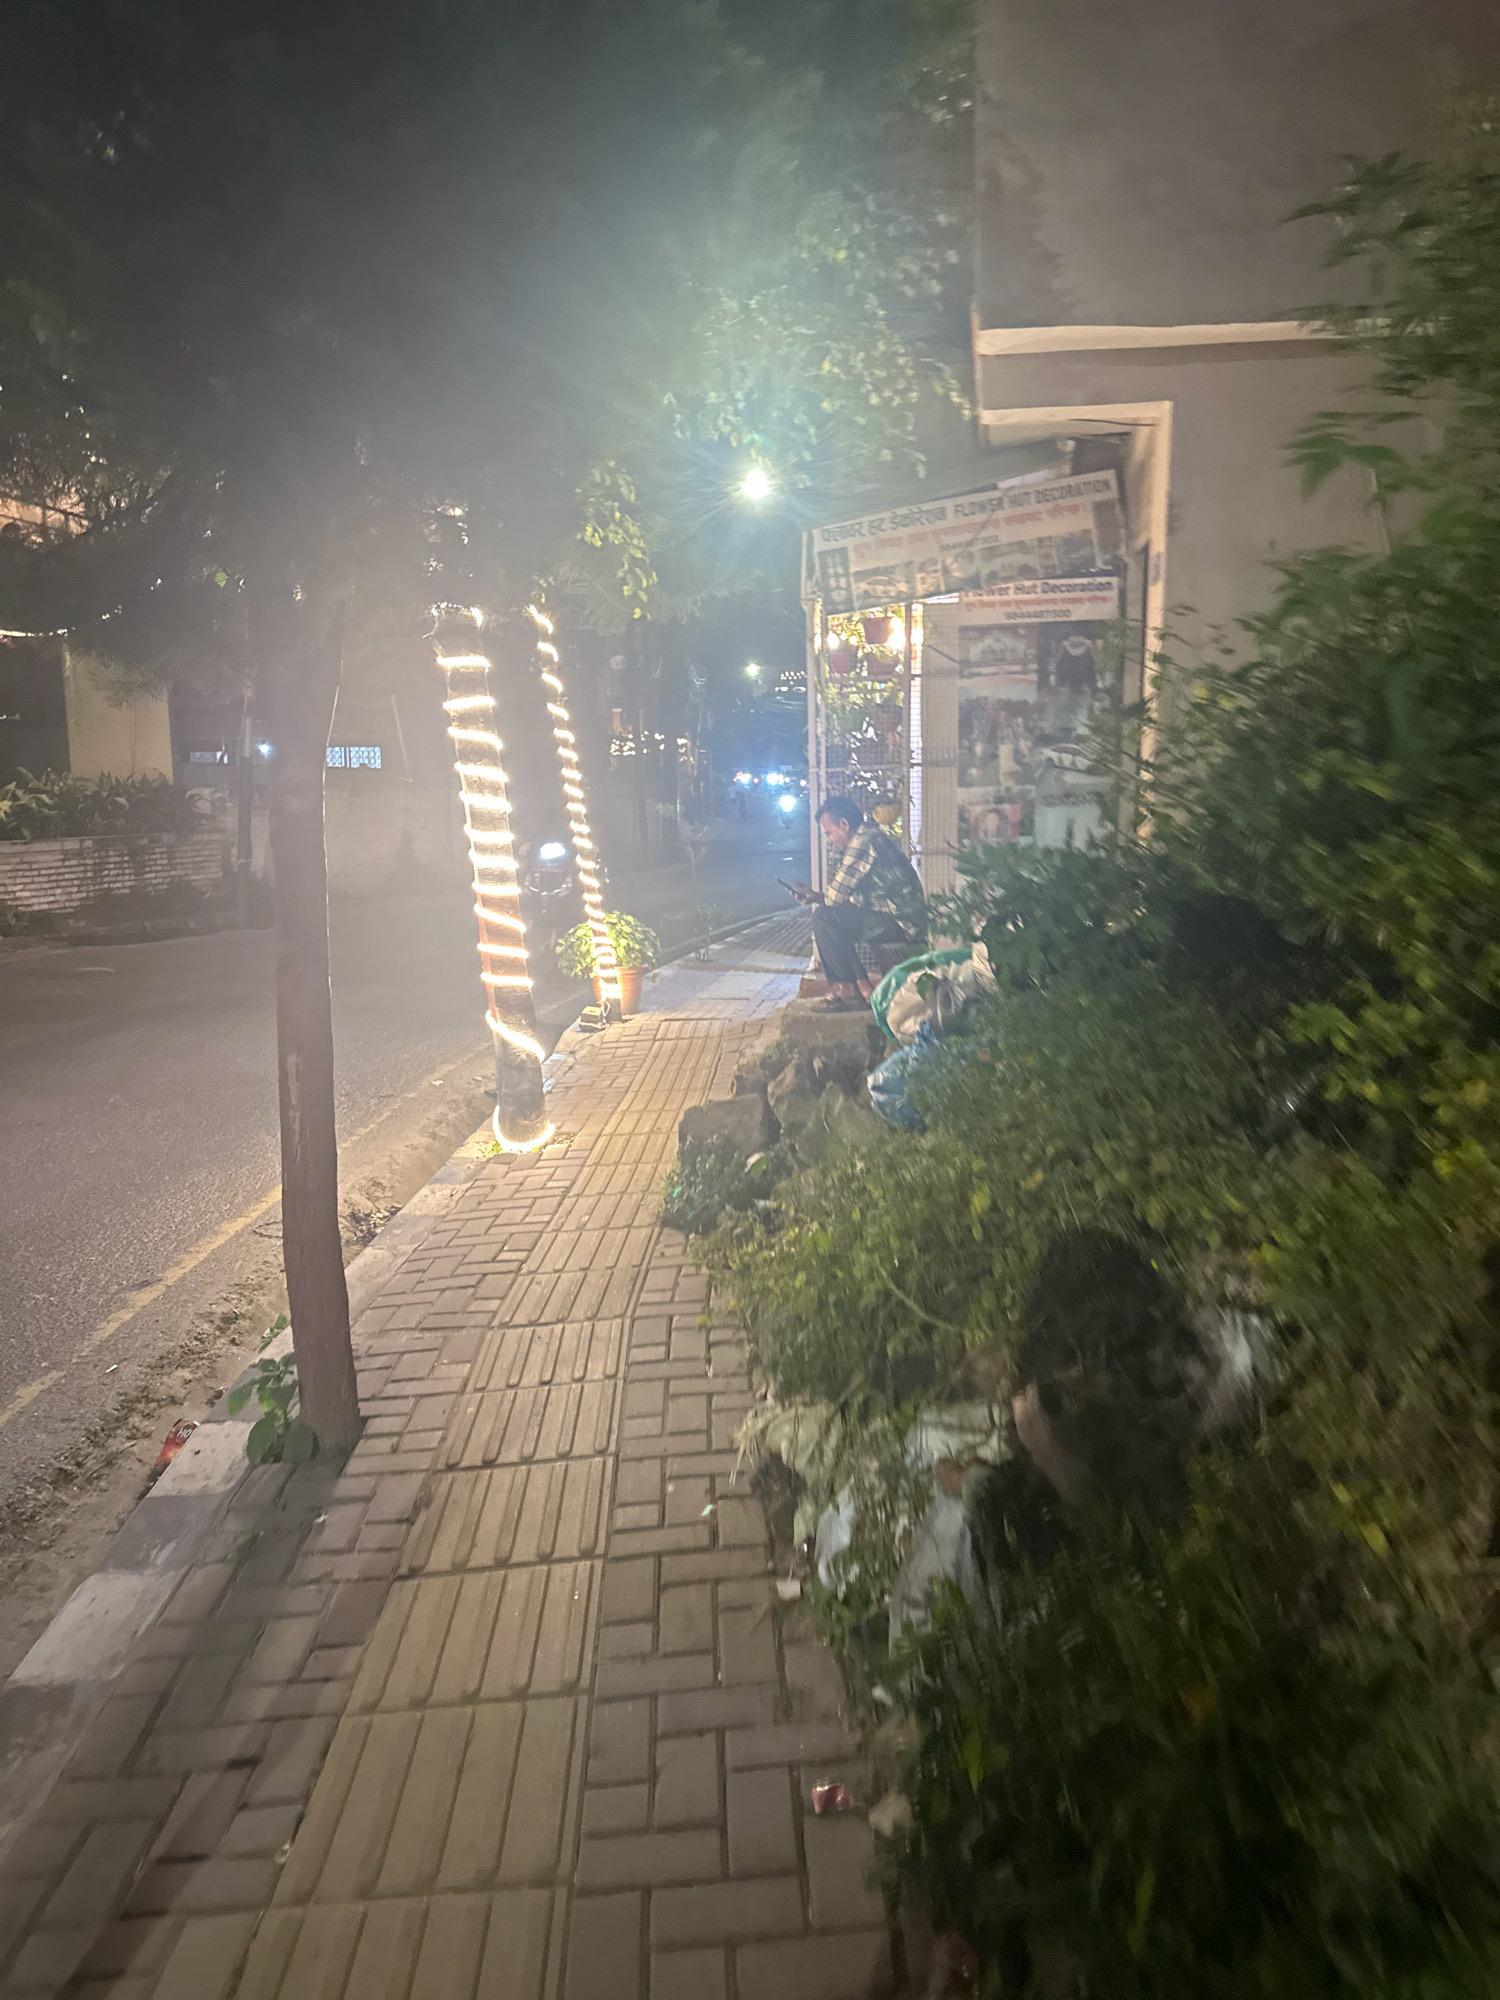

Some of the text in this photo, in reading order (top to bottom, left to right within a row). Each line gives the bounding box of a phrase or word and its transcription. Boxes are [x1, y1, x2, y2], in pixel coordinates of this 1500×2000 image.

[953, 497, 1005, 517] FLOWER
[1034, 478, 1112, 504] DECORATION
[1041, 581, 1114, 594] Decoration
